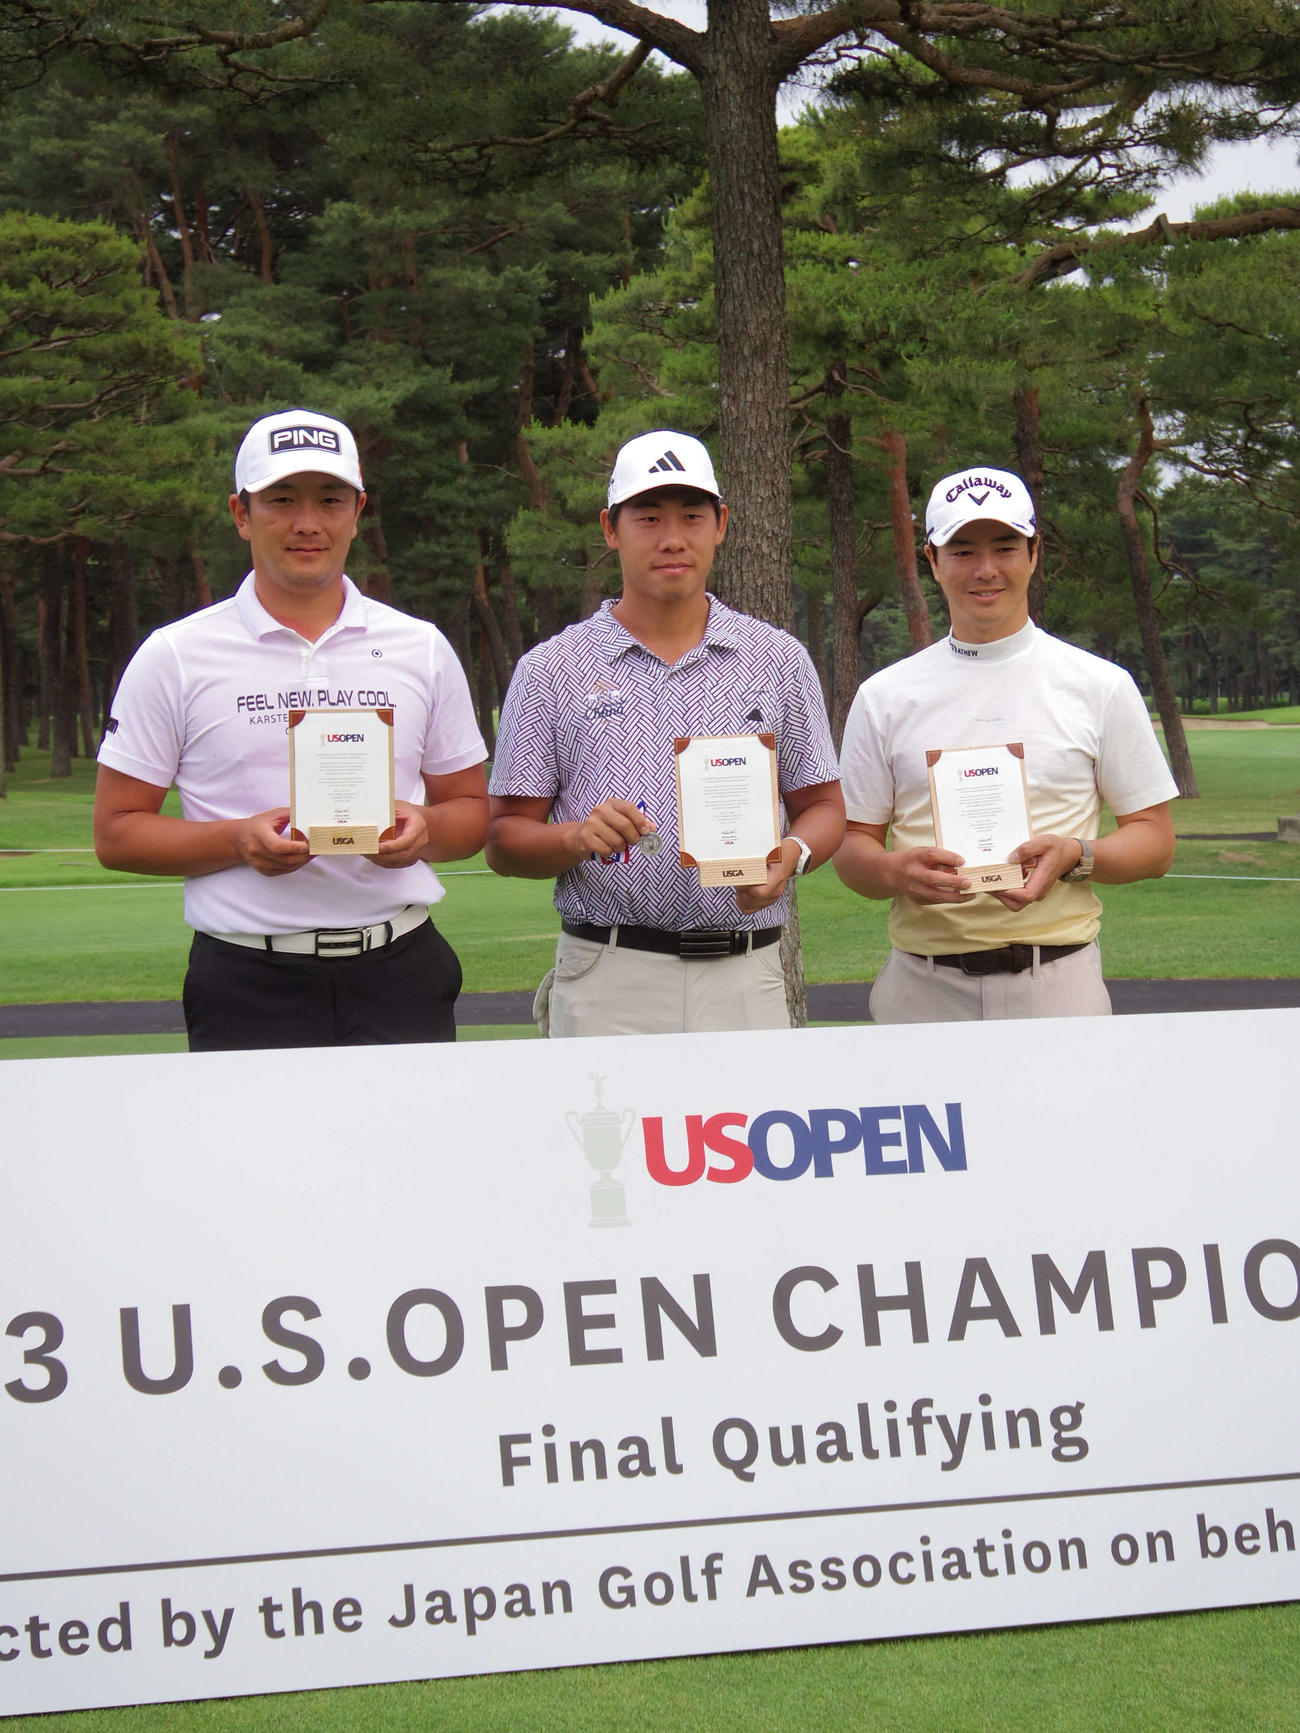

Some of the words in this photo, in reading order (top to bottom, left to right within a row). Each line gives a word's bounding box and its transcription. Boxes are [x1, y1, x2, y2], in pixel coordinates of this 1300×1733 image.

[273, 429, 337, 449] PING
[945, 476, 1011, 502] Callaway
[237, 694, 275, 713] FEEL
[277, 690, 315, 709] NEW.
[317, 689, 354, 707] PLAY
[357, 689, 397, 708] COOL.
[332, 837, 355, 846] USGA
[722, 869, 744, 877] USGA
[981, 874, 1002, 882] USGA
[4, 1312, 69, 1404] 3
[772, 1238, 1300, 1352] CHAMPIO
[499, 1416, 684, 1487] Final
[712, 1393, 1090, 1483] Qualifying
[0, 1600, 133, 1662] cted
[160, 1597, 235, 1660] by
[258, 1586, 363, 1640] the
[387, 1579, 573, 1637] Japan
[598, 1552, 724, 1610] Golf
[745, 1535, 1088, 1598] Association
[1110, 1529, 1175, 1567] on
[1196, 1507, 1296, 1559] beh
